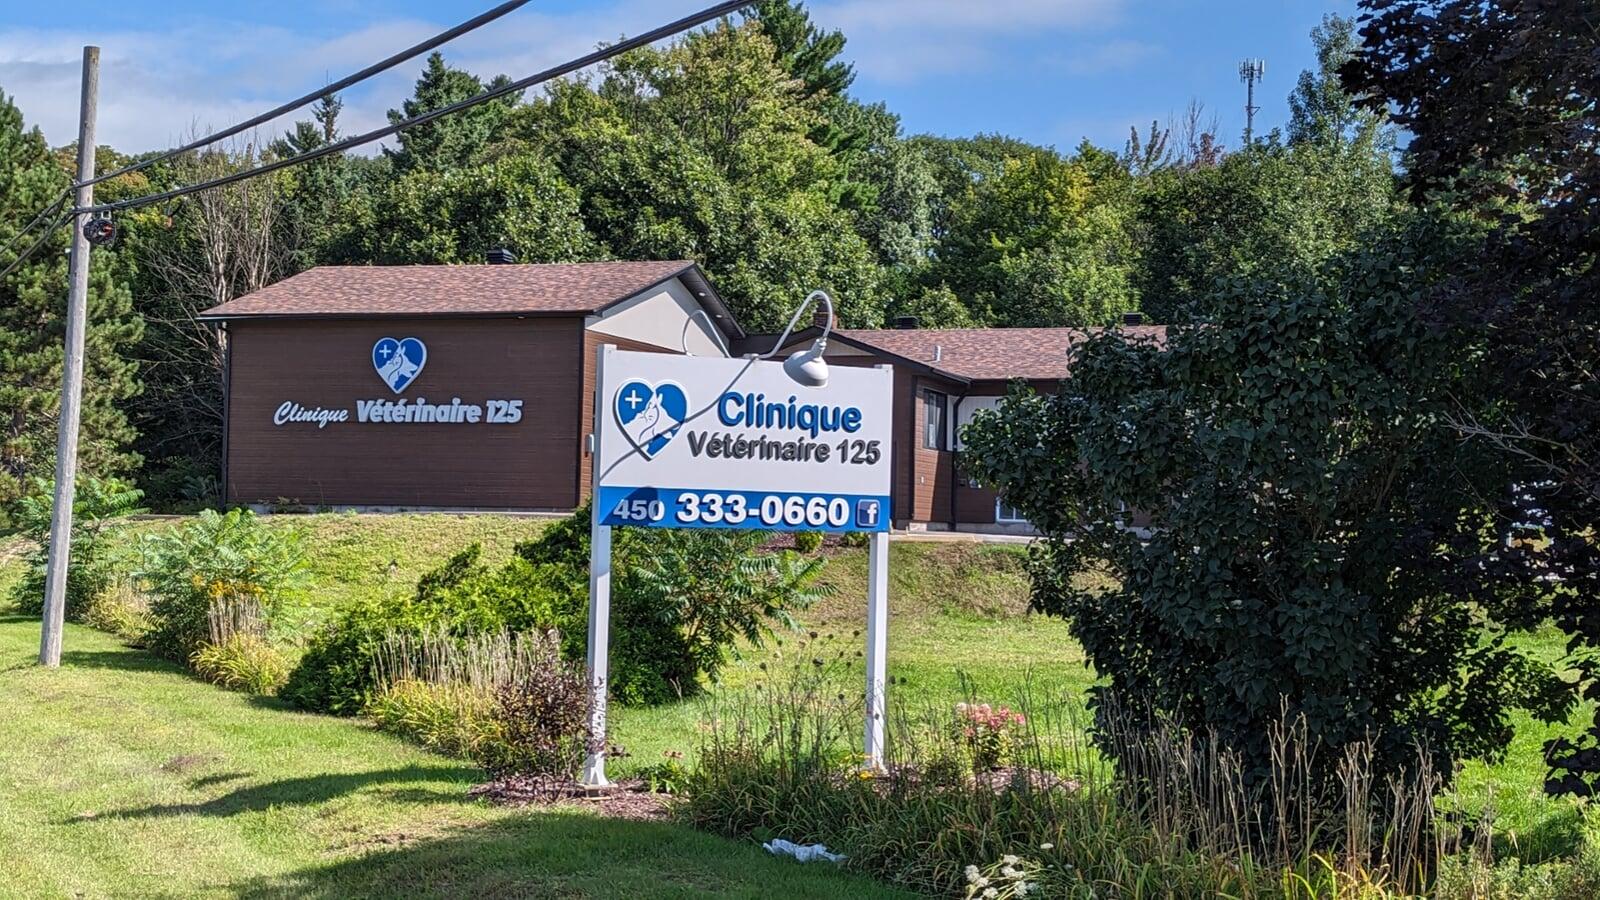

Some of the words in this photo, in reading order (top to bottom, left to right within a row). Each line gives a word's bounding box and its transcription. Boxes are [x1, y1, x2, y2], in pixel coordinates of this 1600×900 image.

[273, 401, 349, 429] Clinique
[356, 397, 481, 424] Vétérinaire
[485, 399, 524, 424] 125
[717, 391, 863, 439] Clinique
[687, 430, 831, 463] Vétérinaire
[837, 439, 881, 465] 125
[613, 499, 665, 521] 450
[675, 493, 850, 526] 333-0660
